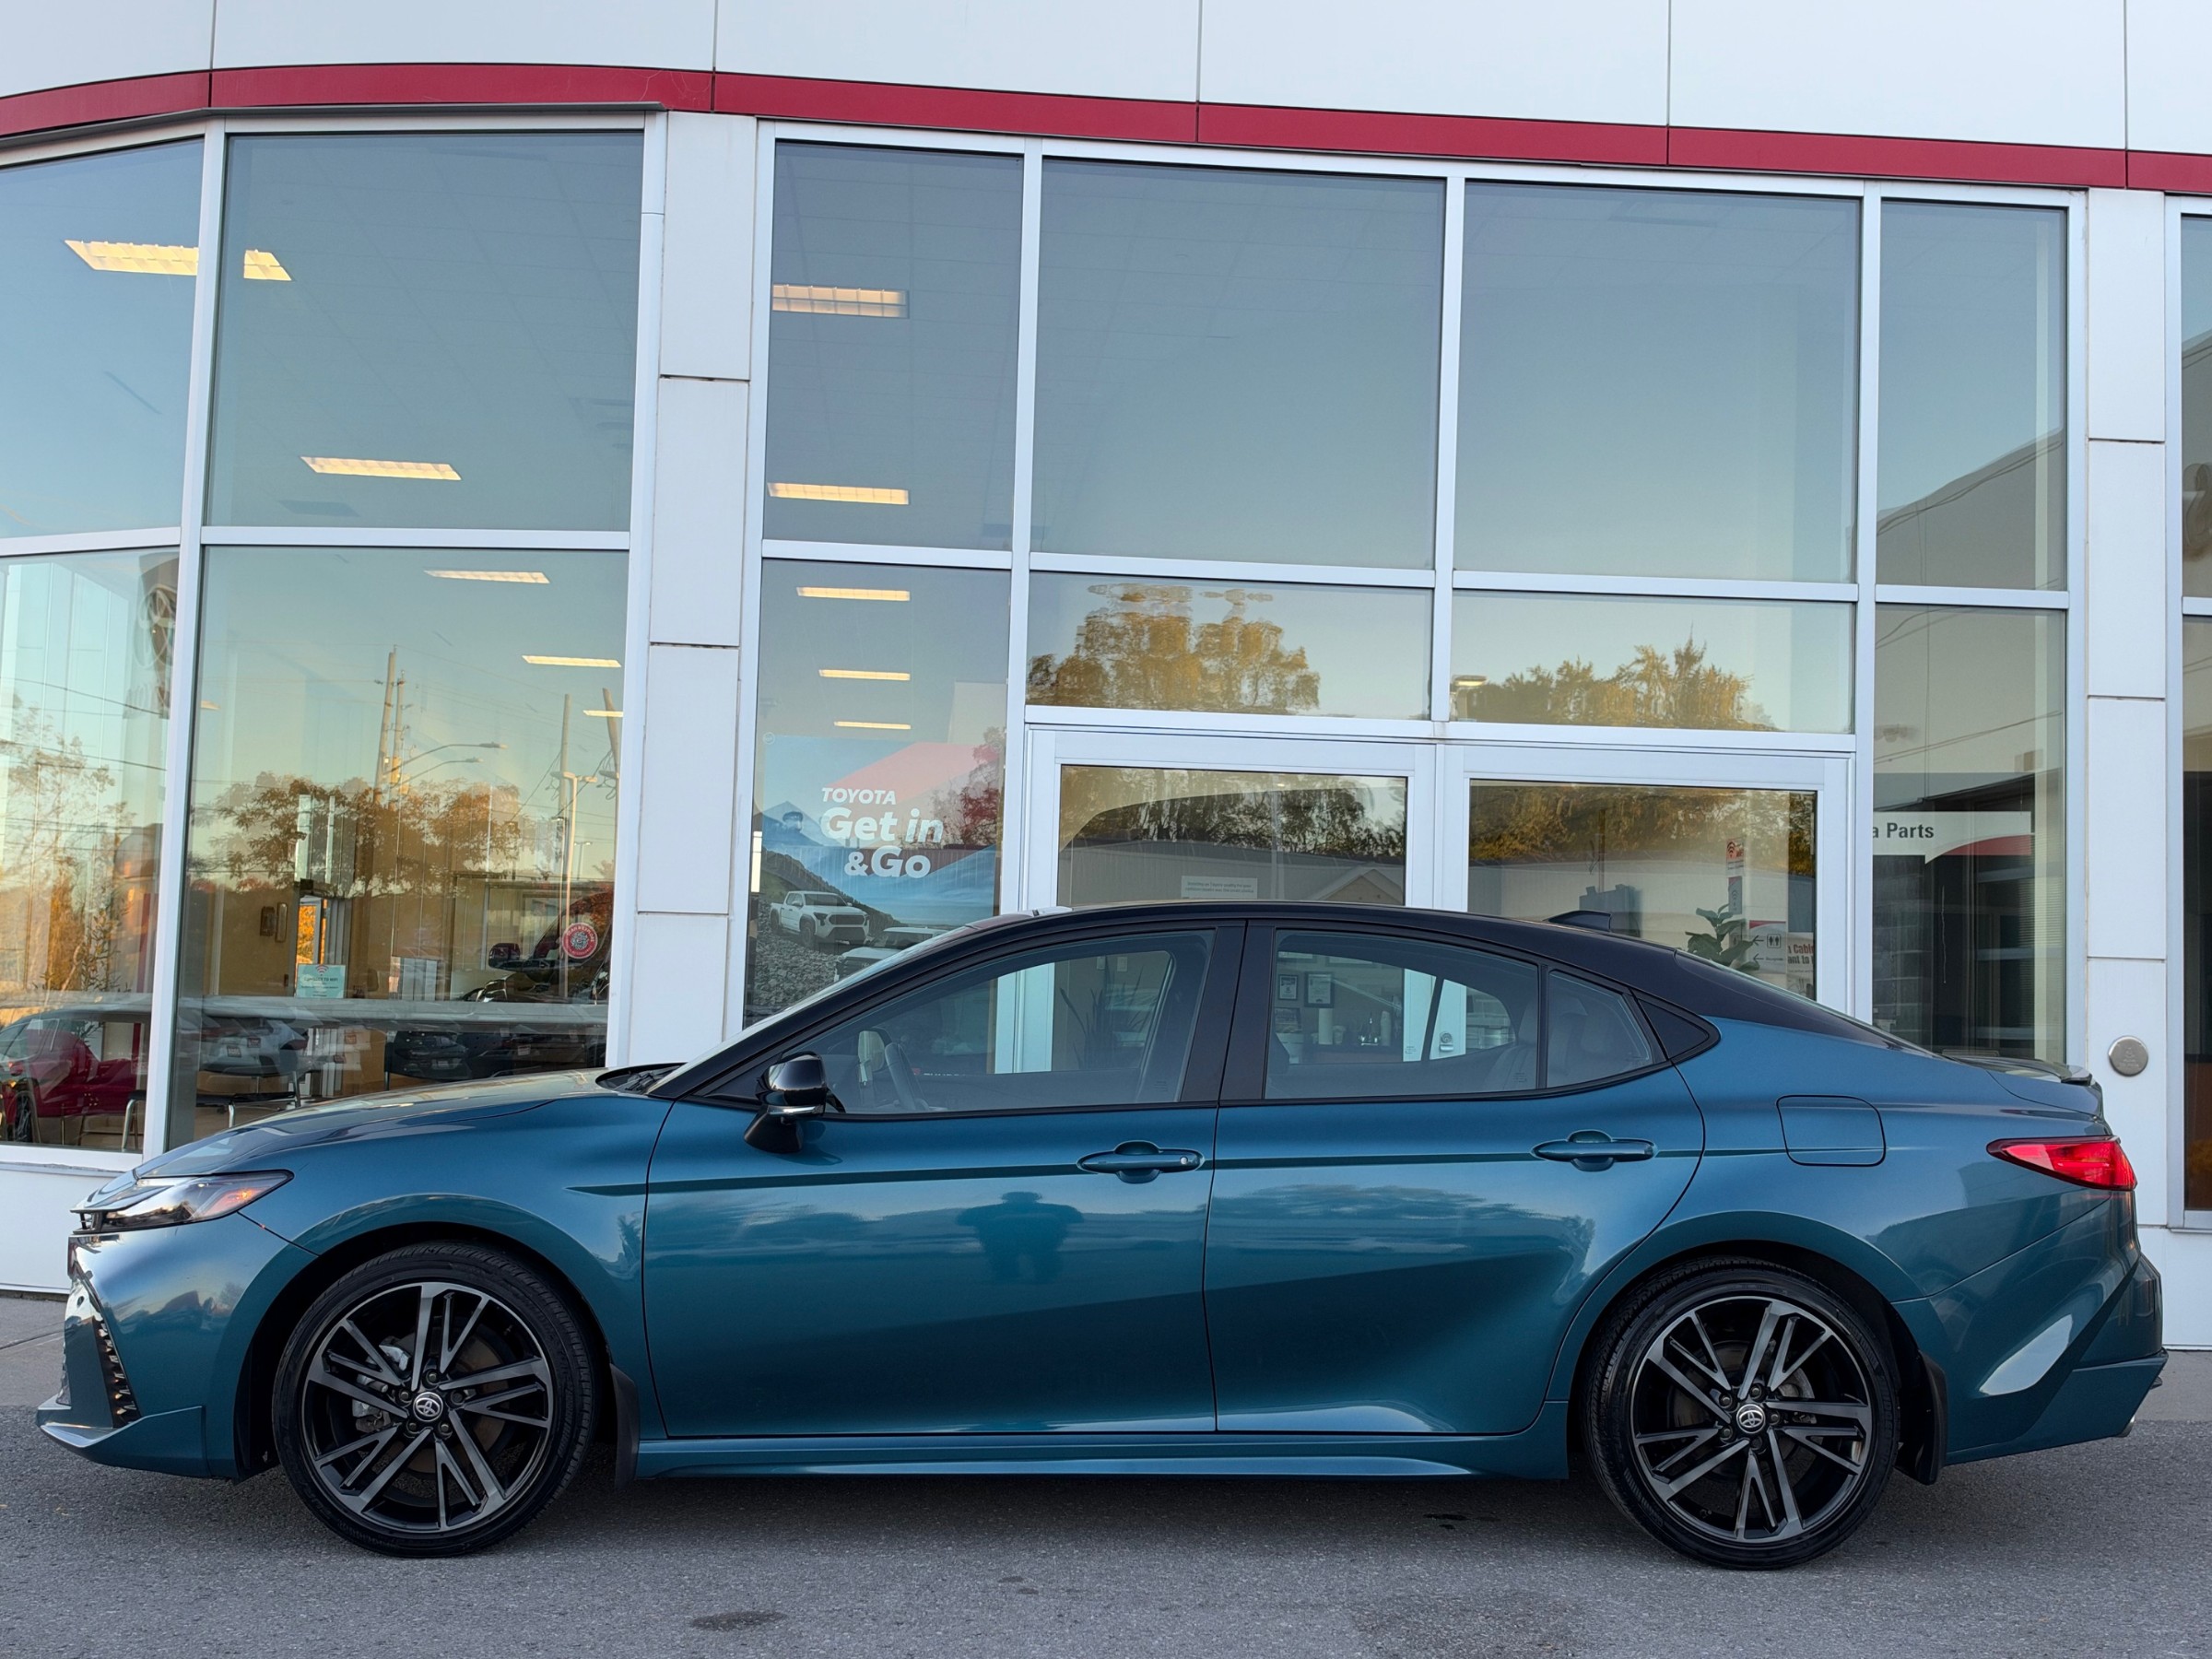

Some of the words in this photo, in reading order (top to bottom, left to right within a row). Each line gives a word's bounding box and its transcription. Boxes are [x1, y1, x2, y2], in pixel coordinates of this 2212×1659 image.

[821, 787, 897, 805] TOYOTA
[820, 806, 898, 841] Get
[905, 807, 944, 843] in
[1887, 822, 1935, 839] Parts
